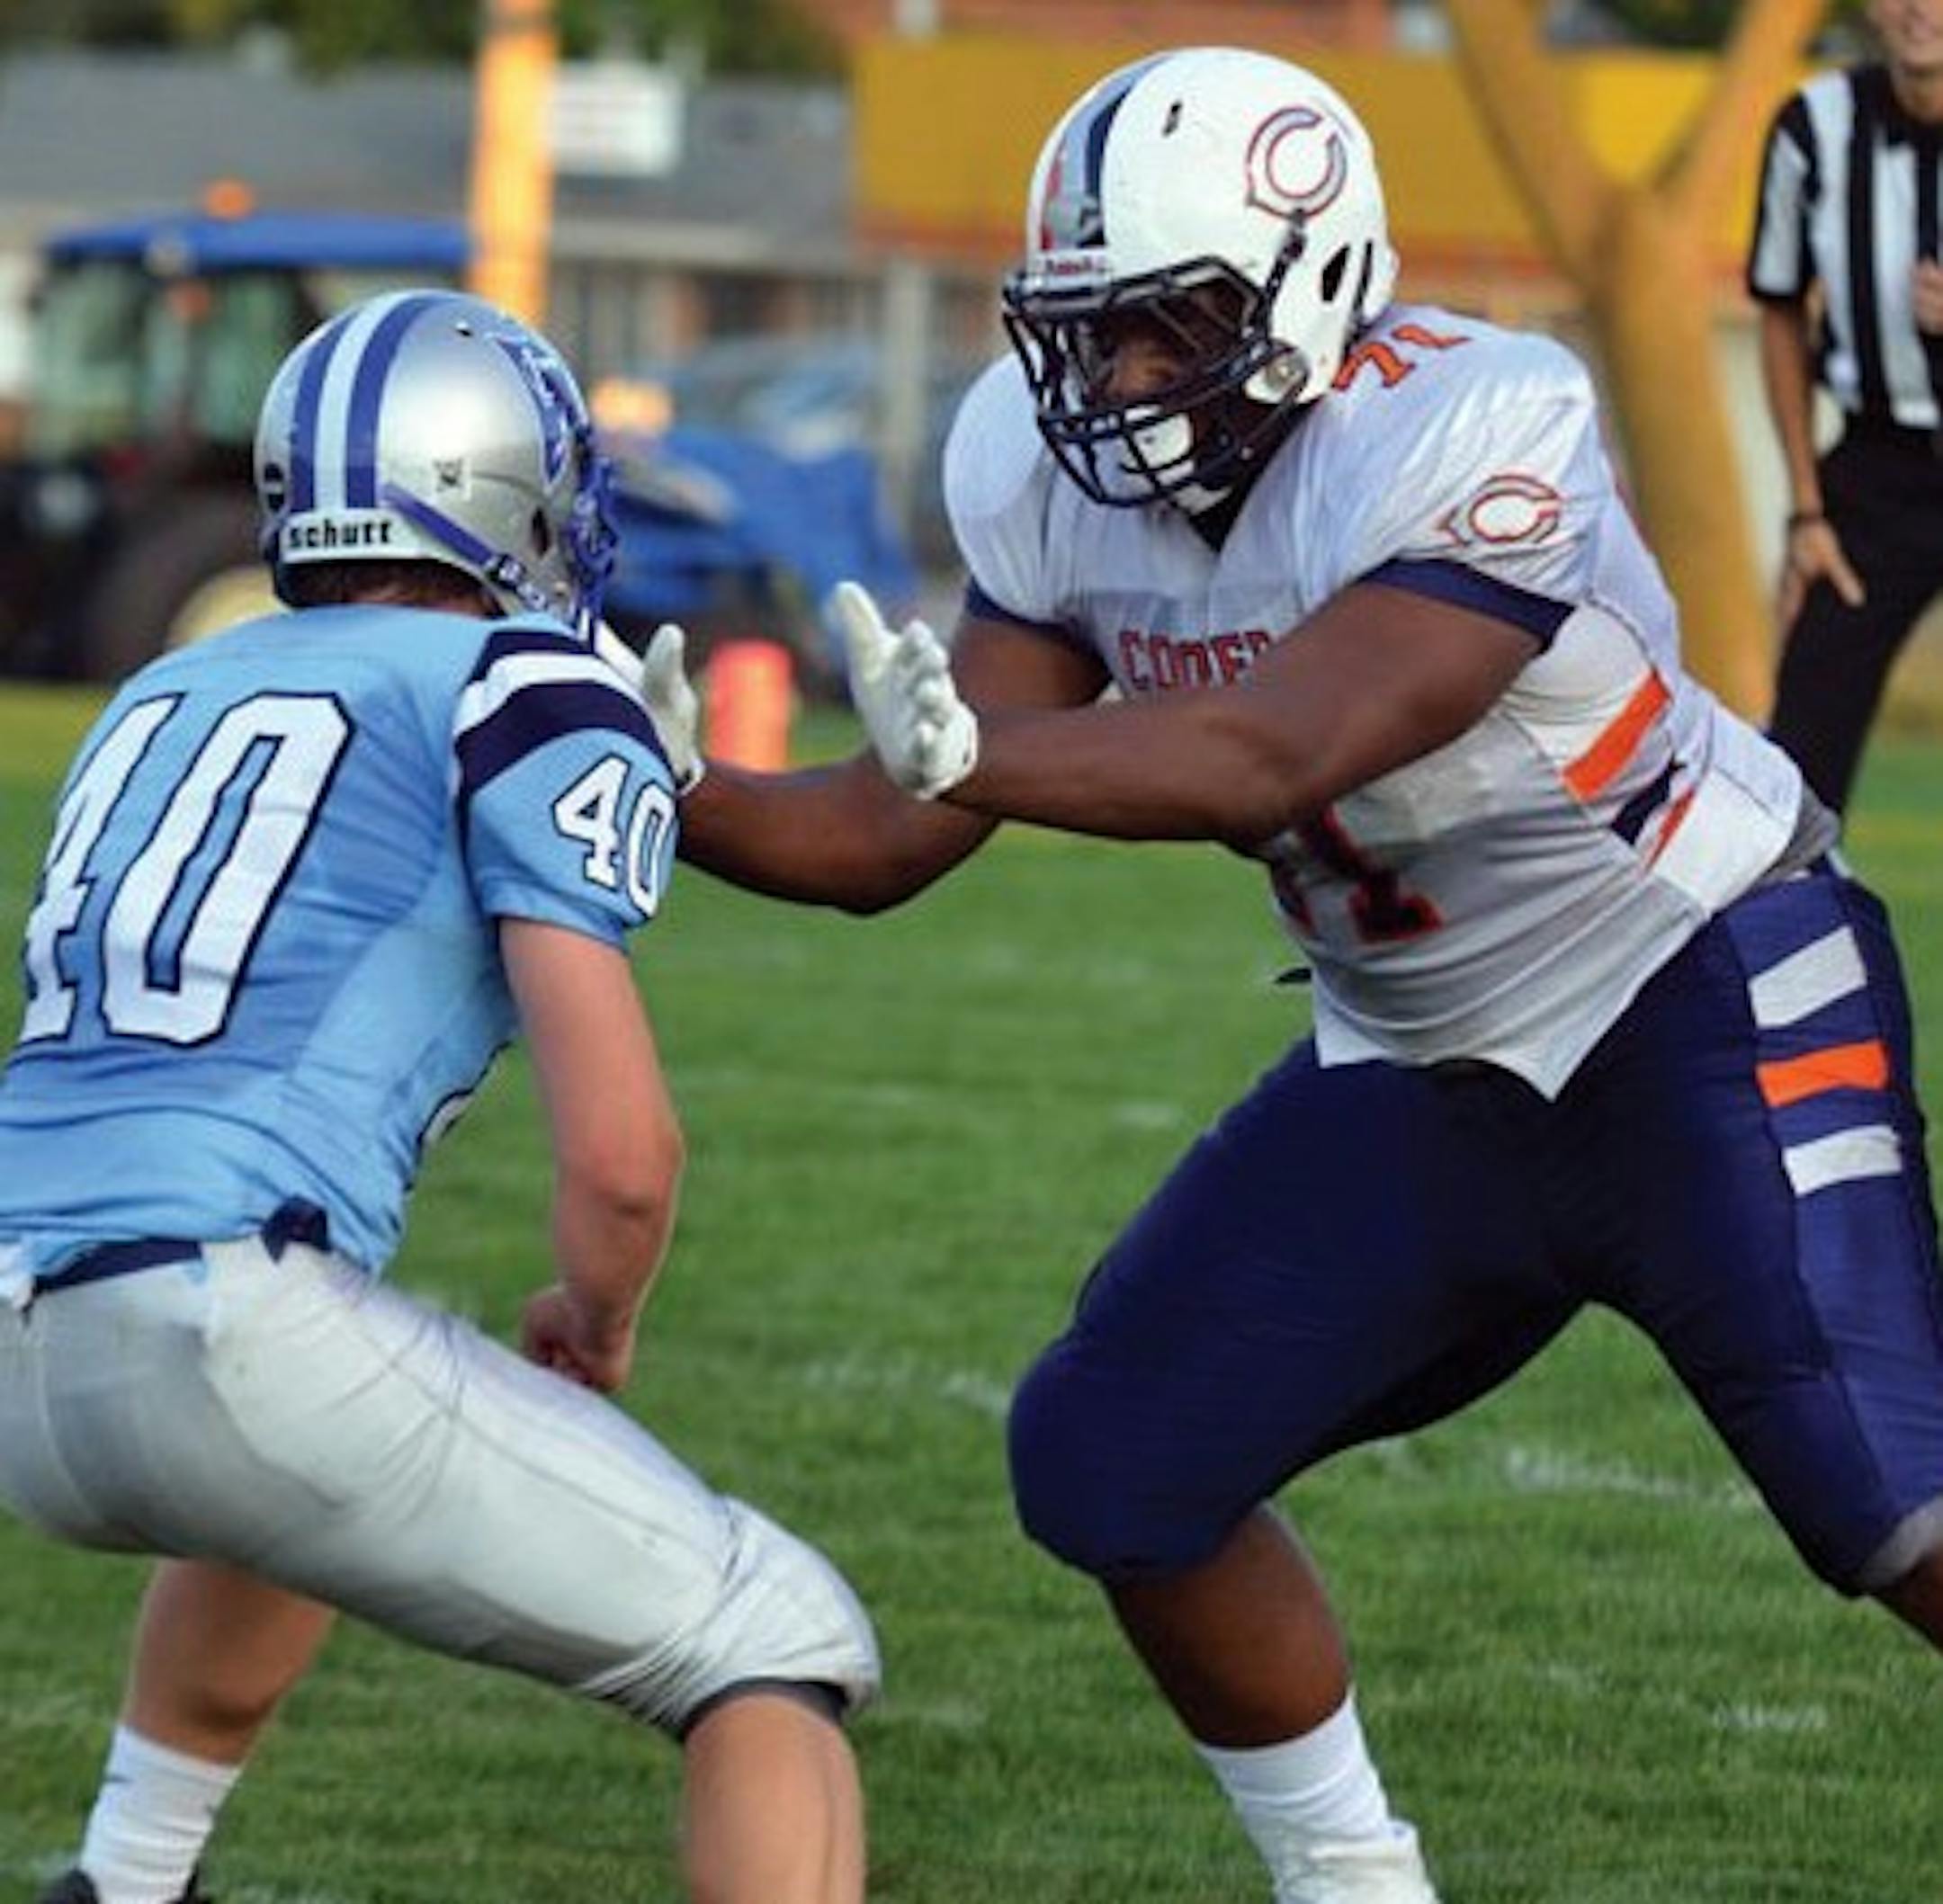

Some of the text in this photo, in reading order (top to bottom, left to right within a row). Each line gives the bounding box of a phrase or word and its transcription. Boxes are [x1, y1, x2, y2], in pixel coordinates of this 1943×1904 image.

[1244, 105, 1348, 219] C
[289, 518, 392, 548] schutt
[20, 689, 356, 1050] 40
[551, 751, 676, 921] 40
